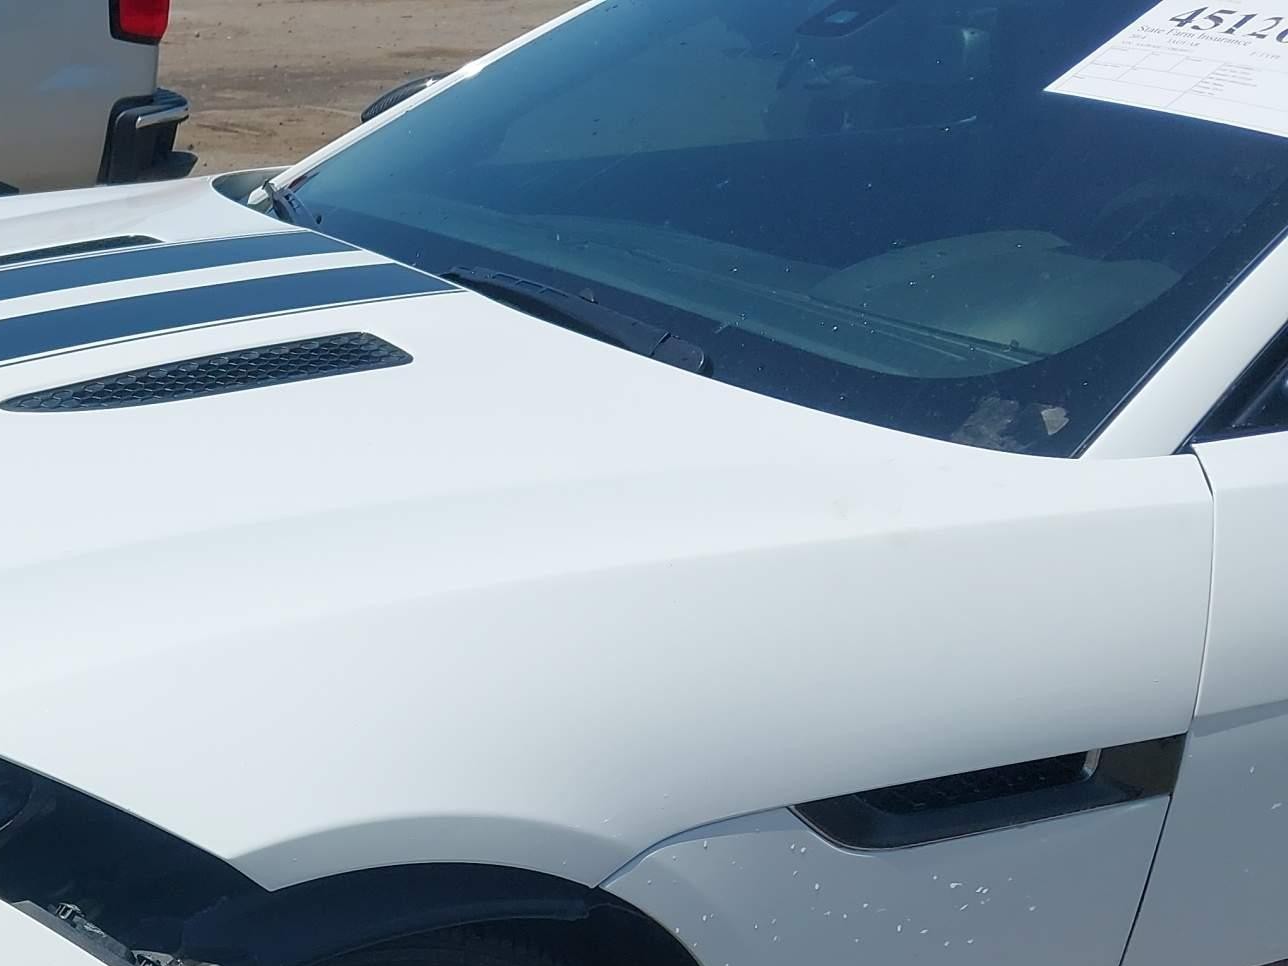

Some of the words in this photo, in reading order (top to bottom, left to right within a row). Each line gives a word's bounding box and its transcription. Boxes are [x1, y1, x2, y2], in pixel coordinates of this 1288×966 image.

[1137, 25, 1166, 35] State
[1166, 28, 1196, 38] Farm
[1196, 32, 1253, 47] Insurance
